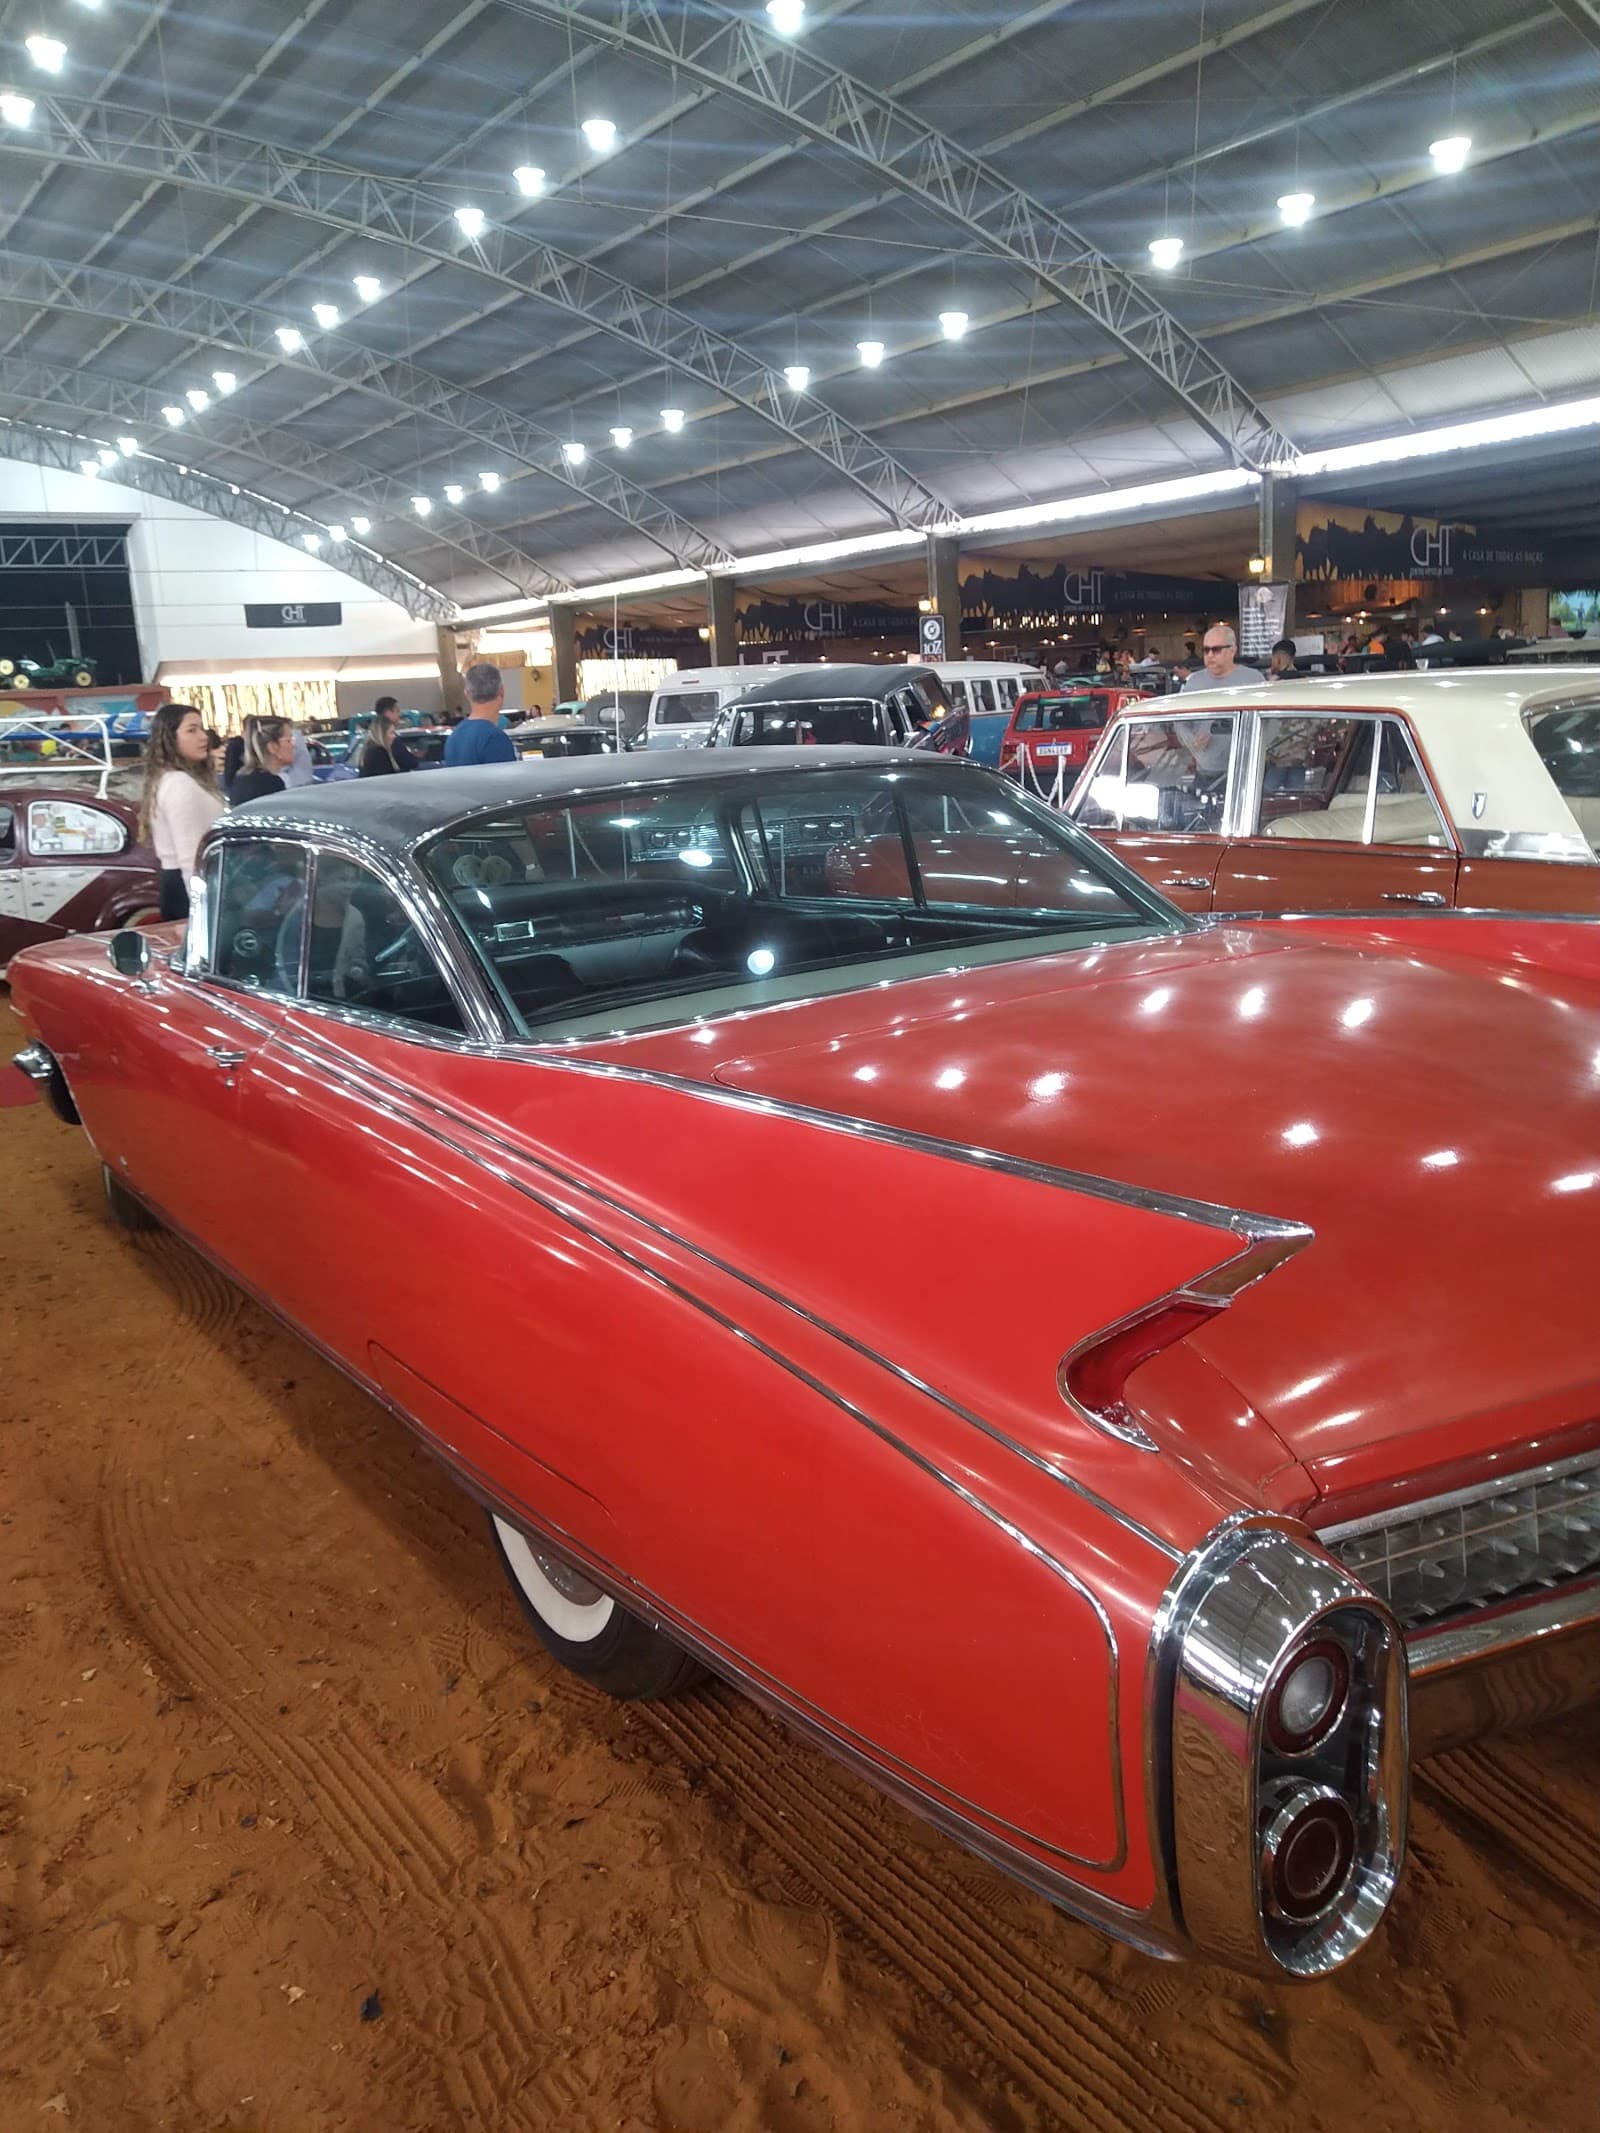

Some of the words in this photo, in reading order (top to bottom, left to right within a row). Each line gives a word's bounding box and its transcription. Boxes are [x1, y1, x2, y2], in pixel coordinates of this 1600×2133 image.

[1410, 525, 1453, 566] CHT
[1468, 550, 1484, 561] CASA
[1063, 571, 1104, 604] CHT
[281, 605, 305, 620] CHT
